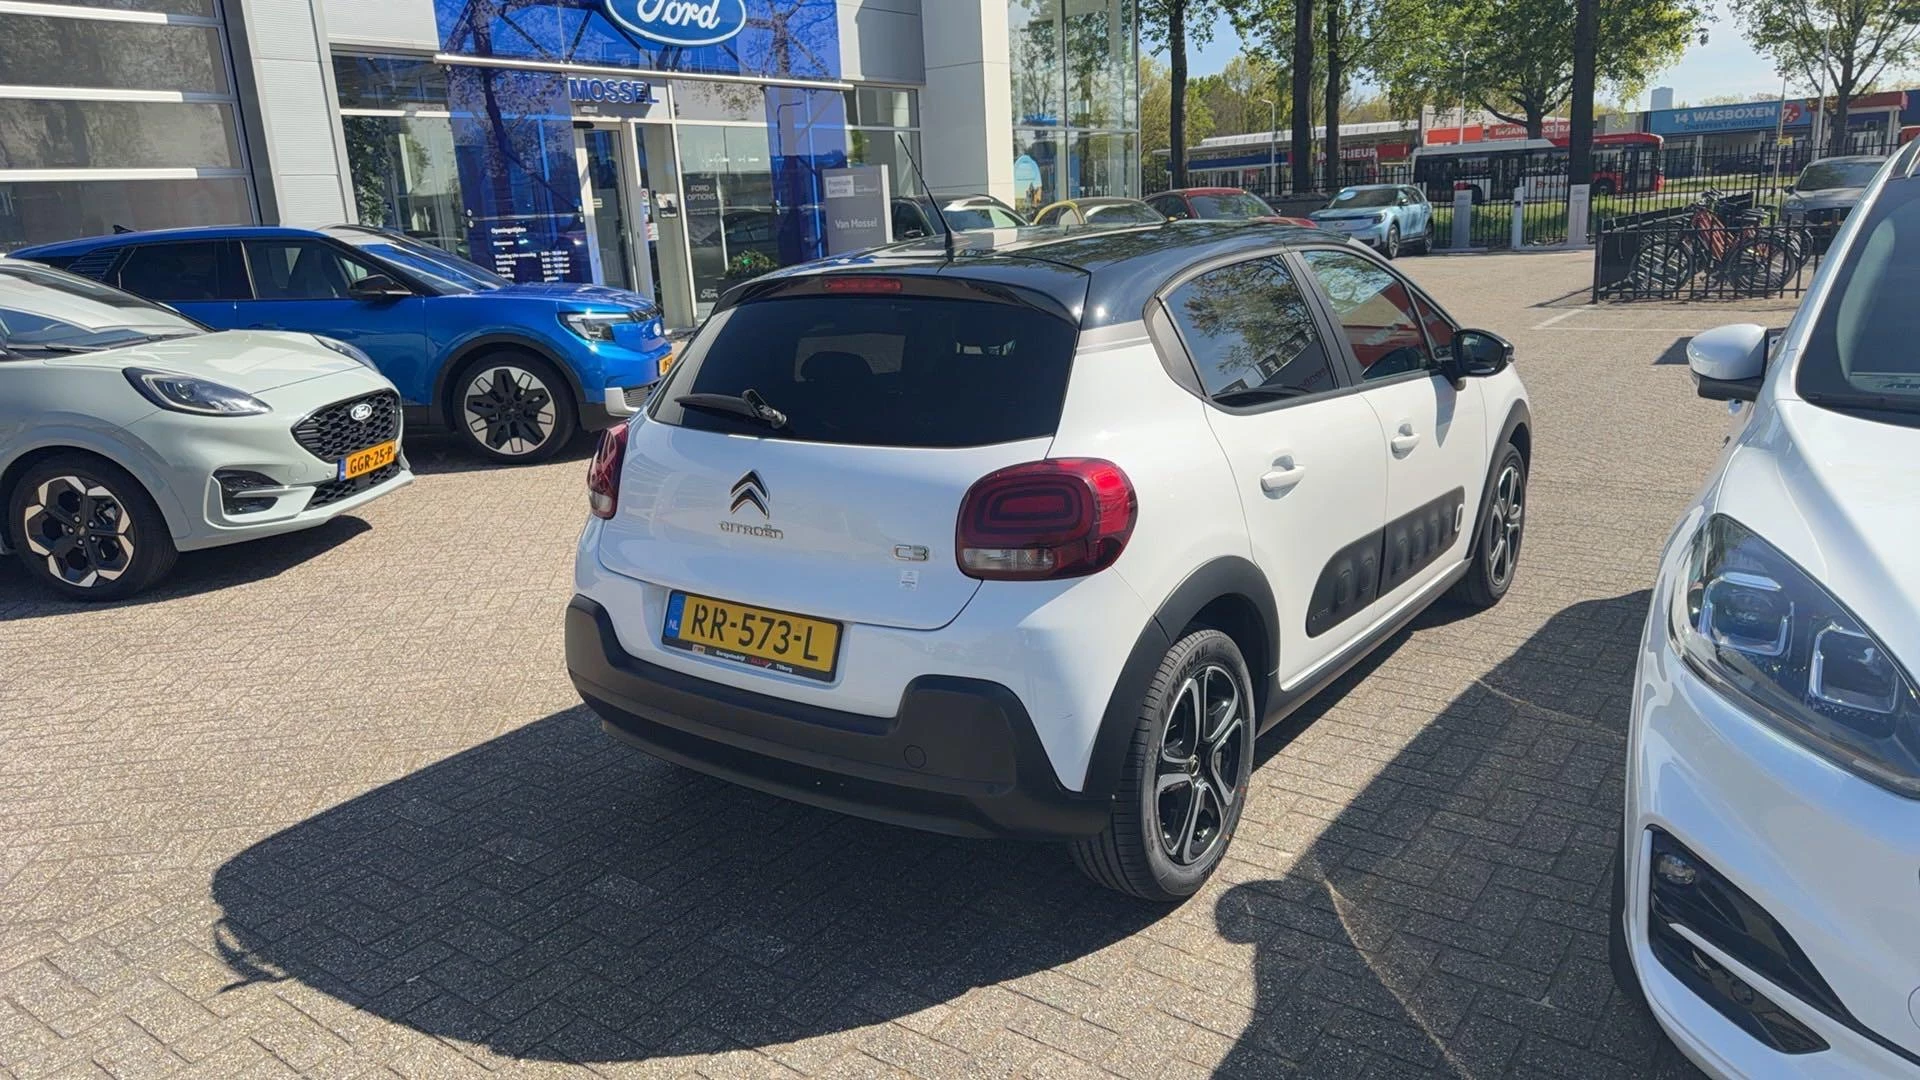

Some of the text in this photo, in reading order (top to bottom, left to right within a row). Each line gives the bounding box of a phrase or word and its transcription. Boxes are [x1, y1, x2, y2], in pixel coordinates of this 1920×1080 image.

[568, 77, 660, 104] MOSSEL
[1674, 106, 1776, 124] 14 WASBOXEN
[691, 184, 710, 192] FORD
[687, 193, 717, 201] OPTIONS
[835, 217, 878, 228] Van Mossel
[349, 446, 393, 474] GGR-25-P
[894, 544, 930, 561] C3
[668, 619, 679, 631] NL
[690, 603, 819, 662] RR-573-L
